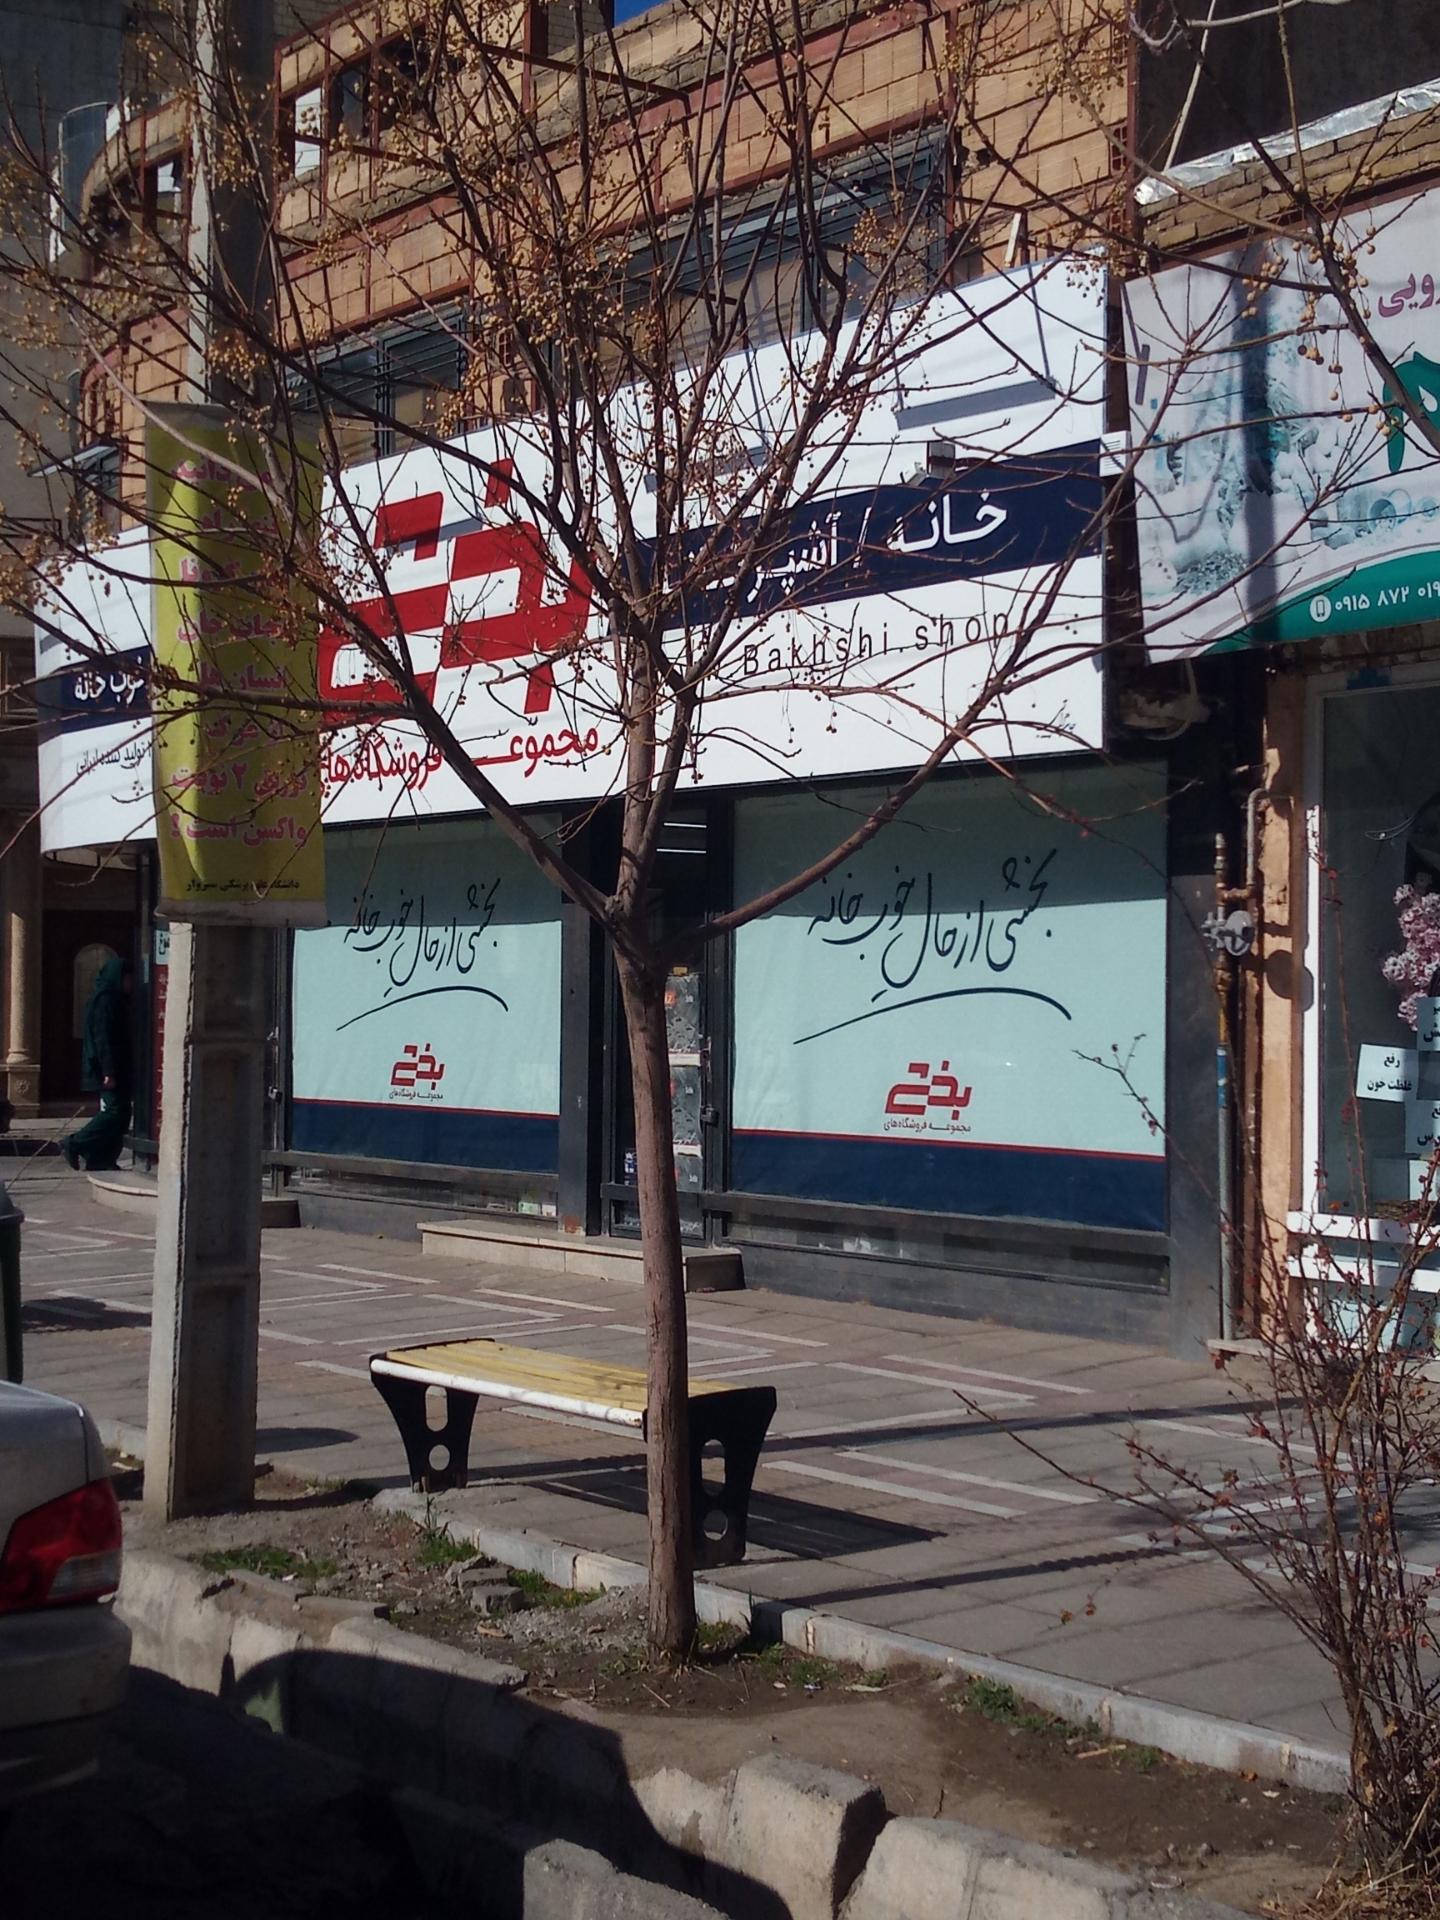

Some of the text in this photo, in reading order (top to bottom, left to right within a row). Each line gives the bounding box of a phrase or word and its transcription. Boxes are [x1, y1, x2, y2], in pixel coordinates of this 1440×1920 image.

[1378, 273, 1440, 318] ویی
[886, 487, 1008, 556] خانه
[648, 510, 842, 604] آشپز
[1334, 592, 1371, 612] ۰۹۱۵
[1377, 585, 1410, 607] ۸۷۲
[460, 725, 600, 778] مجموع
[243, 815, 307, 849] واکسن
[1367, 1079, 1386, 1092] خون
